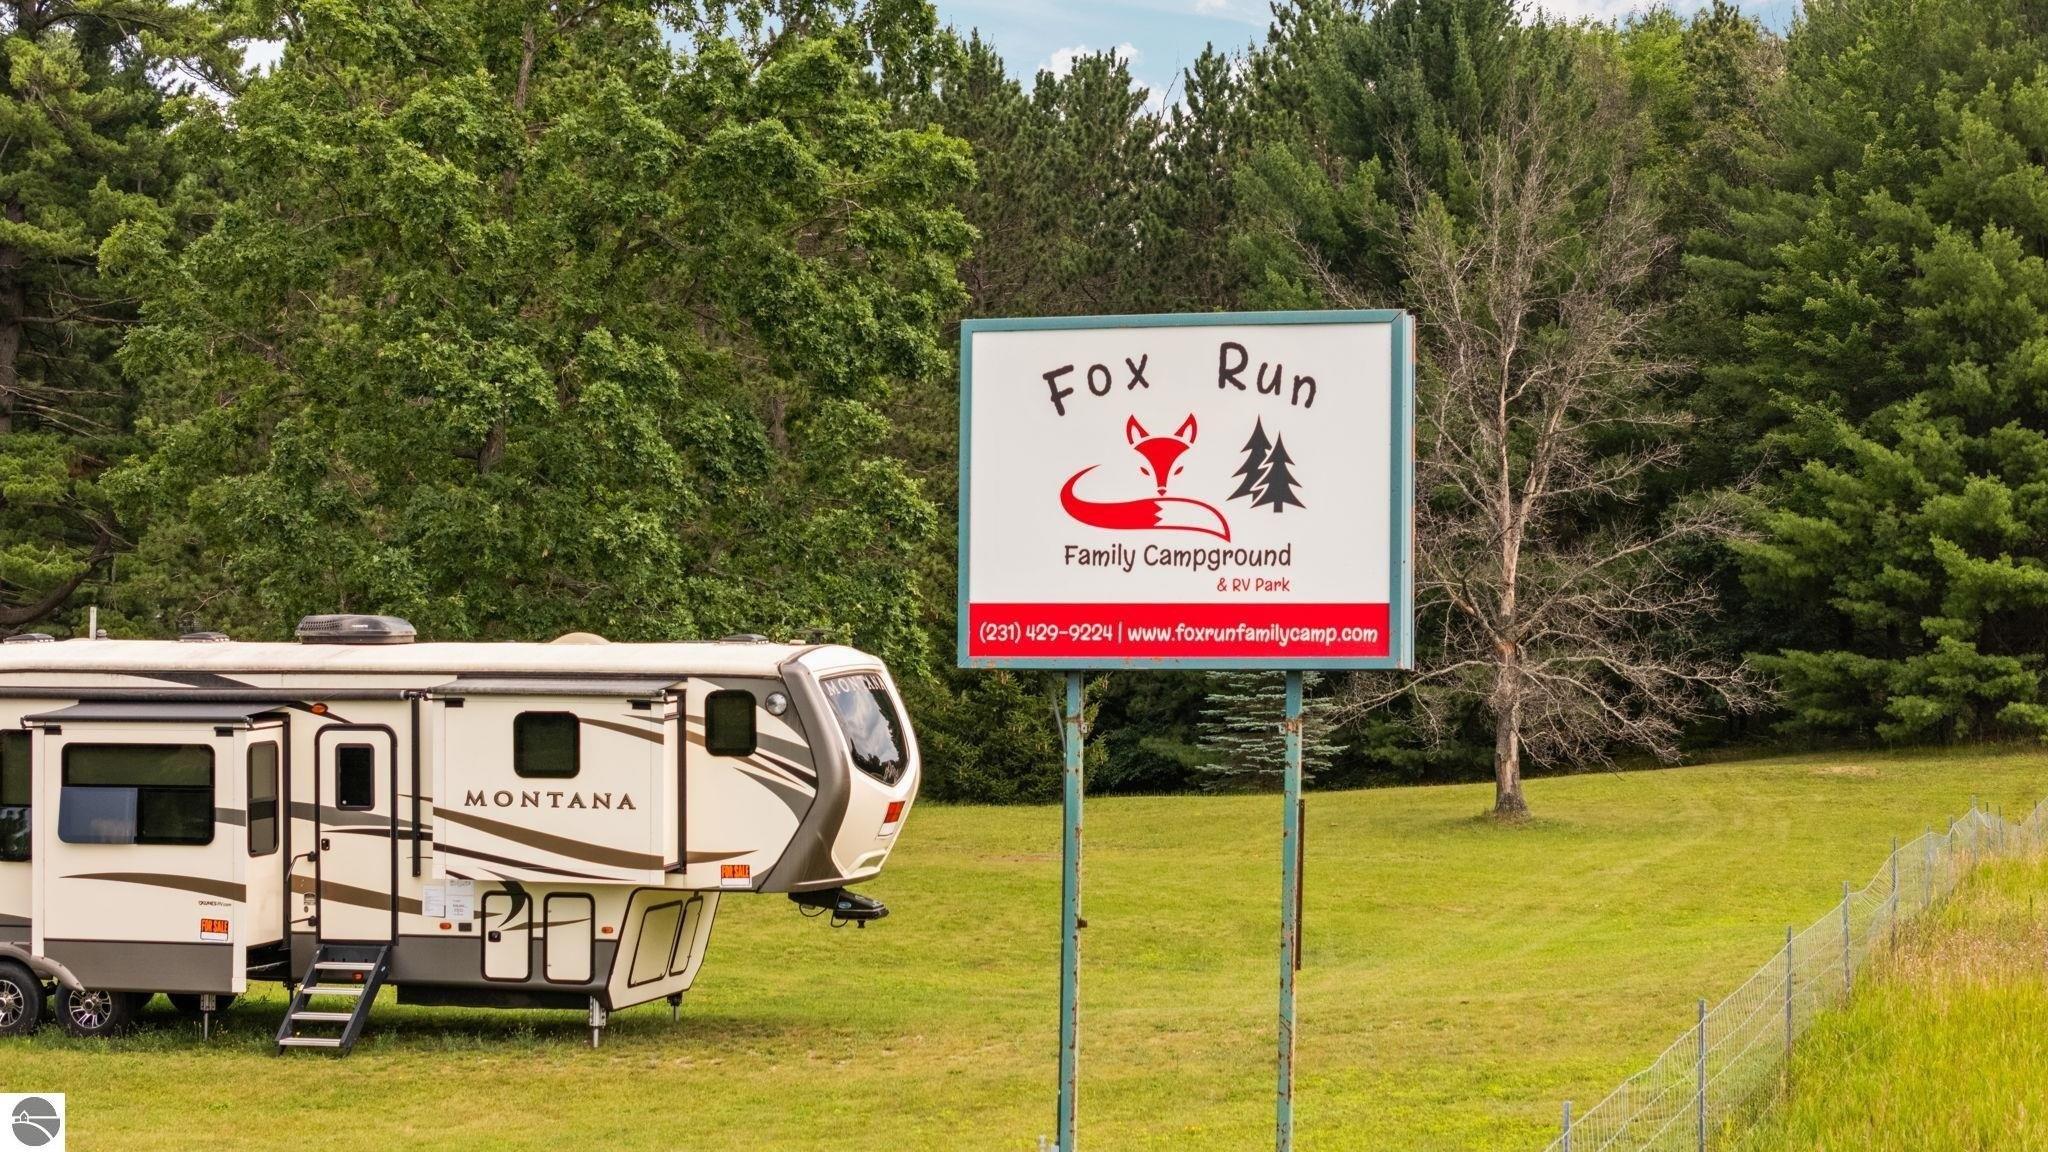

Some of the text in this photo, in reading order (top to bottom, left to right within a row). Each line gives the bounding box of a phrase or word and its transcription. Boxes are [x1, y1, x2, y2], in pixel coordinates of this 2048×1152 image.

[1043, 341, 1317, 416] Fox Run
[1065, 543, 1291, 572] Family Campground
[1217, 577, 1290, 592] & RV Park
[979, 621, 1021, 644] (231)
[1025, 623, 1113, 642] 429-9224
[1127, 622, 1378, 646] www.foxrunfamilycamp.com
[824, 675, 885, 696] MONTANA
[464, 789, 637, 810] MONTANA
[721, 865, 749, 878] FOR SALE
